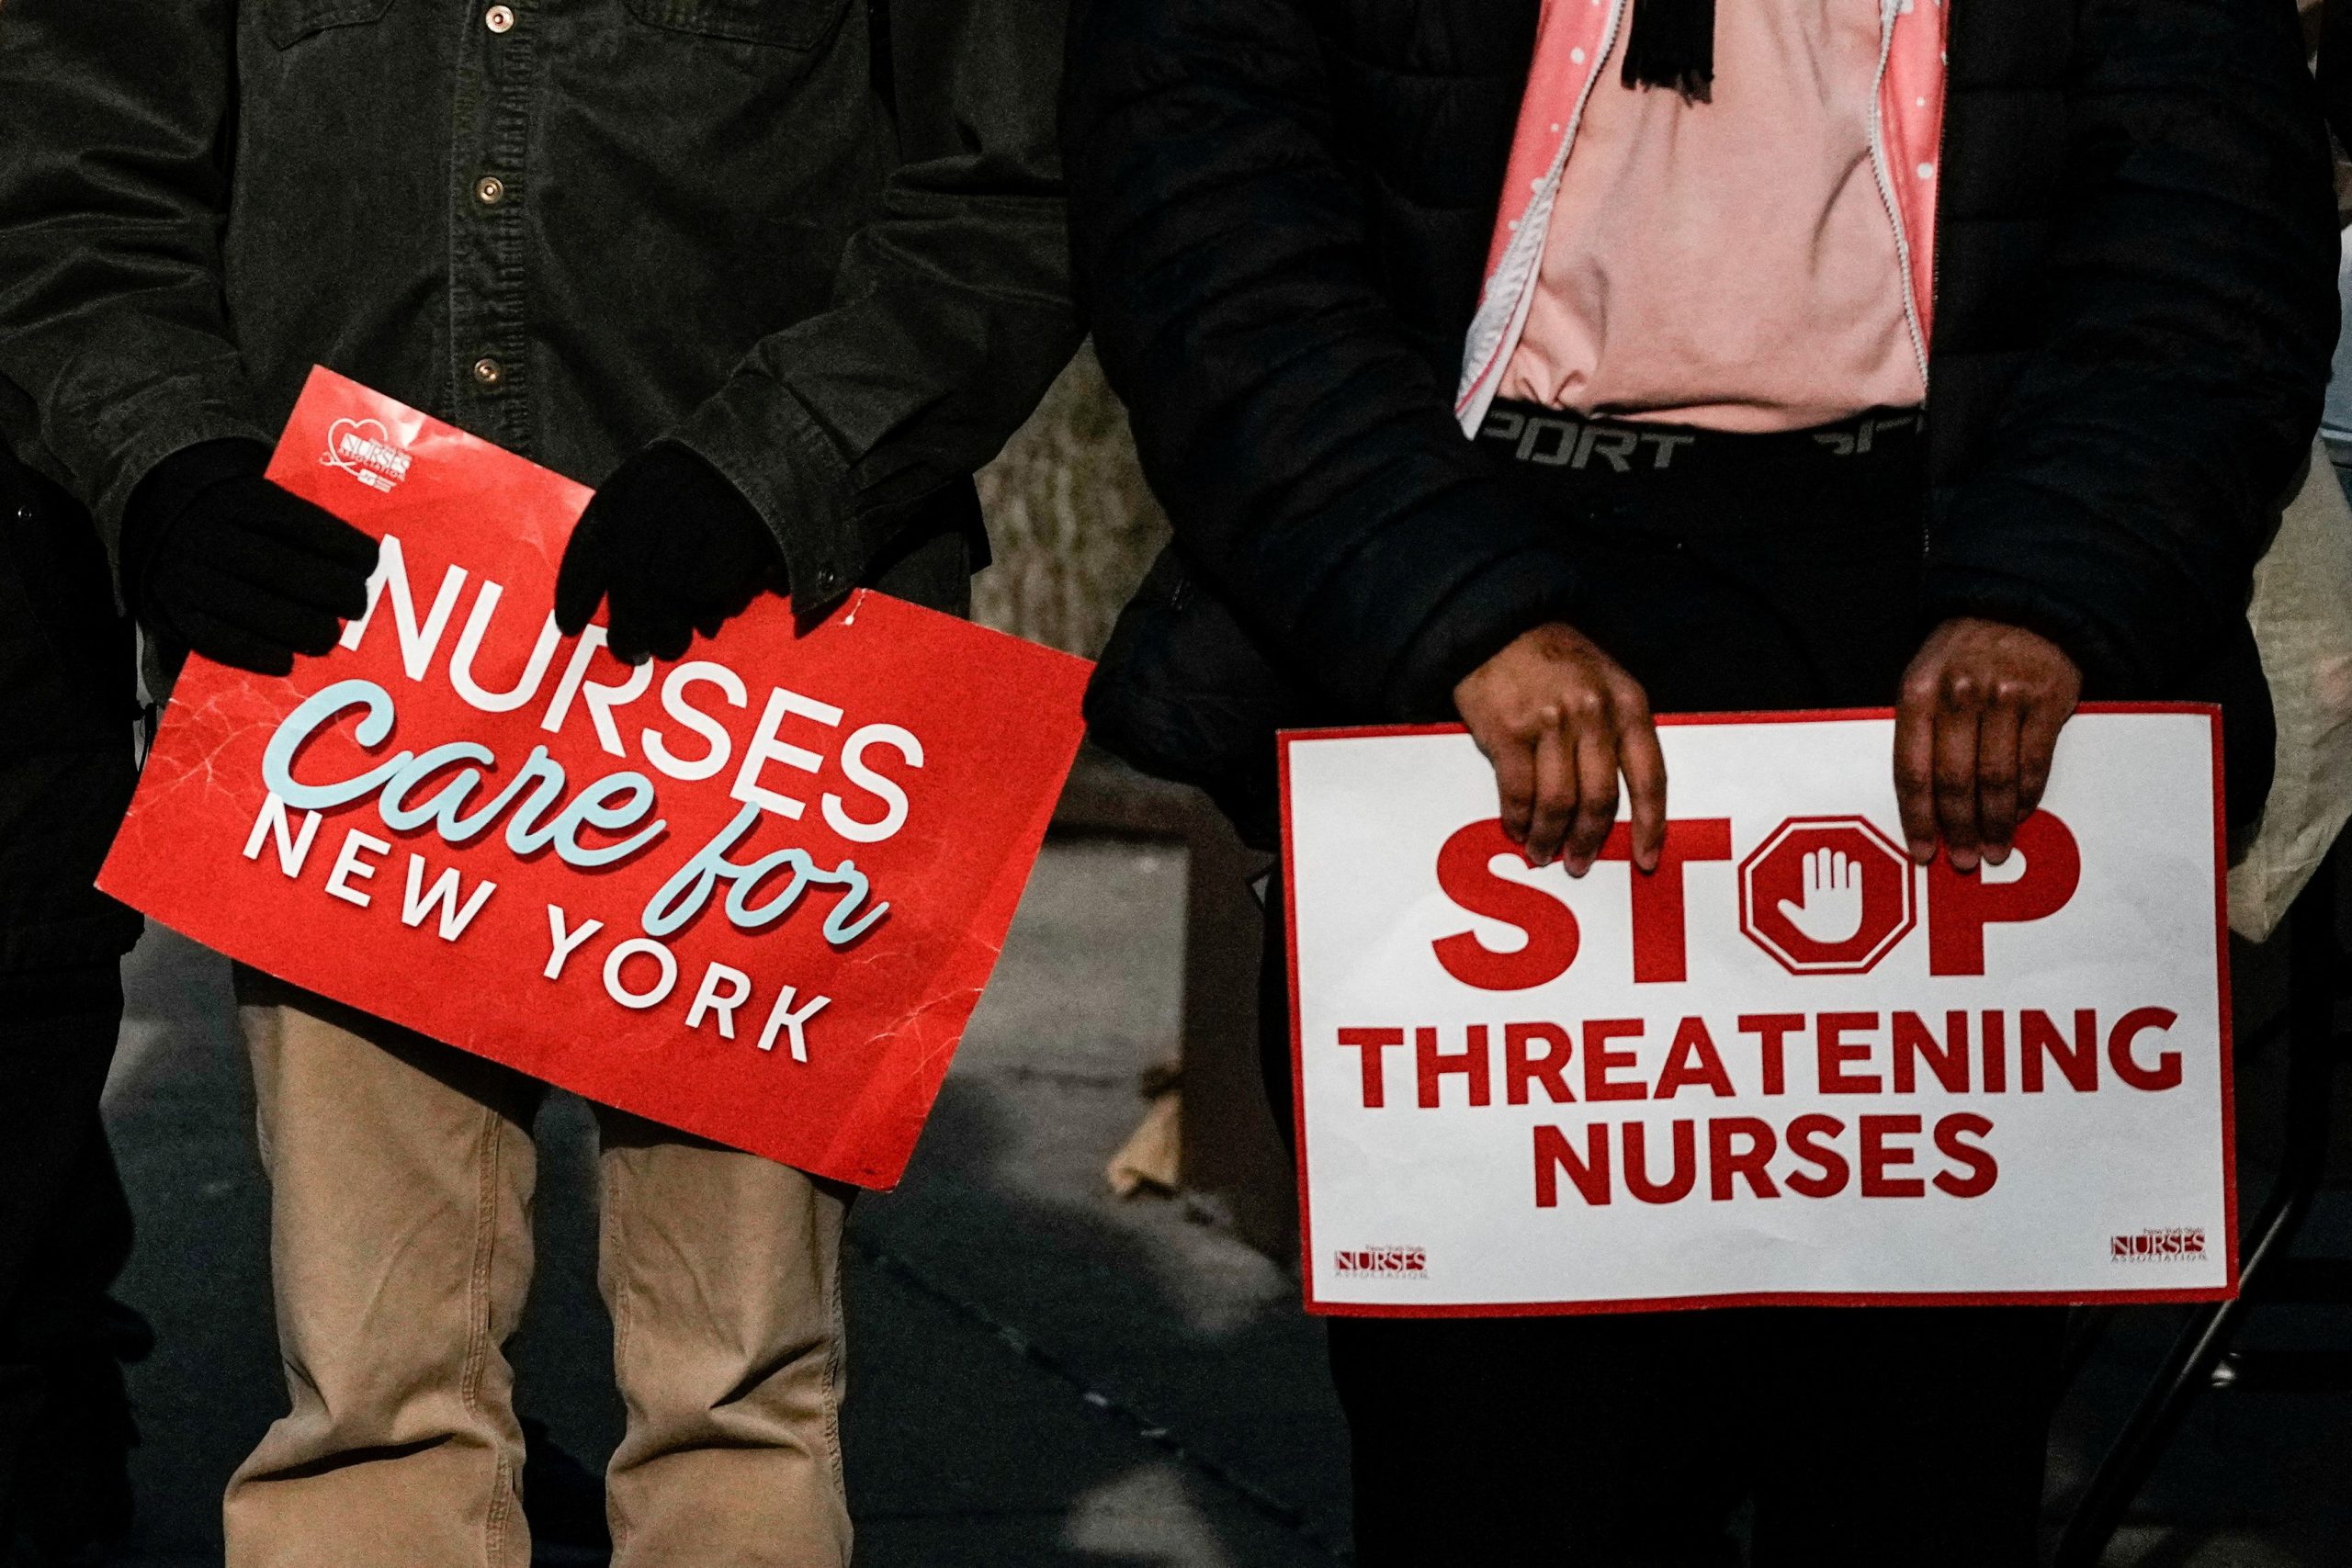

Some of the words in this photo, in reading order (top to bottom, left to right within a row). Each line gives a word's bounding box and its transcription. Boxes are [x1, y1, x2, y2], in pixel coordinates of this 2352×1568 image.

[339, 432, 412, 475] NURSES
[340, 533, 924, 842] NURSES
[262, 679, 666, 866] Care
[641, 800, 889, 944] for
[243, 793, 496, 942] NEW
[545, 905, 831, 1062] YORK
[1431, 808, 2081, 992] STOP
[1338, 1008, 2183, 1110] THREATENING
[1533, 1113, 1997, 1209] NURSES
[1335, 1250, 1426, 1271] NURSES
[1335, 1270, 1429, 1280] ASSOCIATION
[2111, 1234, 2205, 1256] NURSES
[2111, 1255, 2207, 1263] ASSOCIATION
